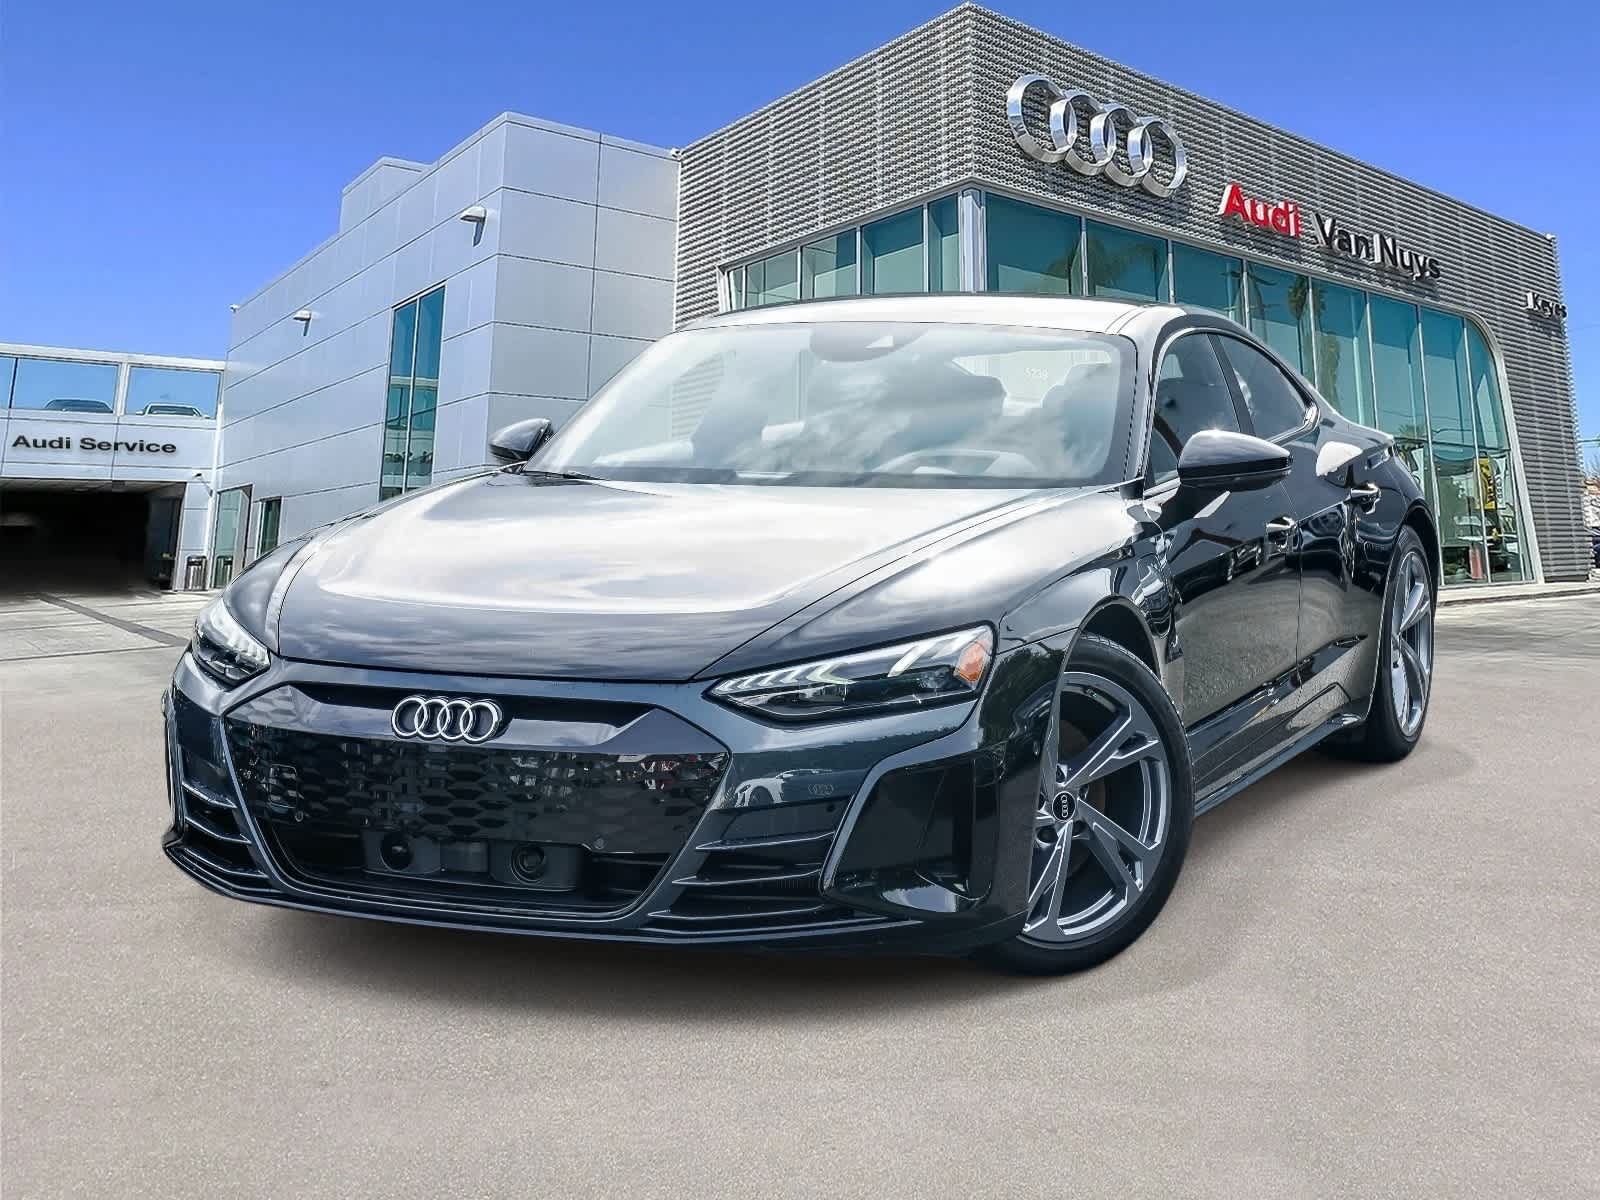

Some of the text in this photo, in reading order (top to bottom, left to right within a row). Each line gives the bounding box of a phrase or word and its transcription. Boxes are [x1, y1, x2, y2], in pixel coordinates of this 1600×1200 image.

[1219, 182, 1442, 281] Audi Van Nuys
[12, 435, 177, 454] Audi Service
